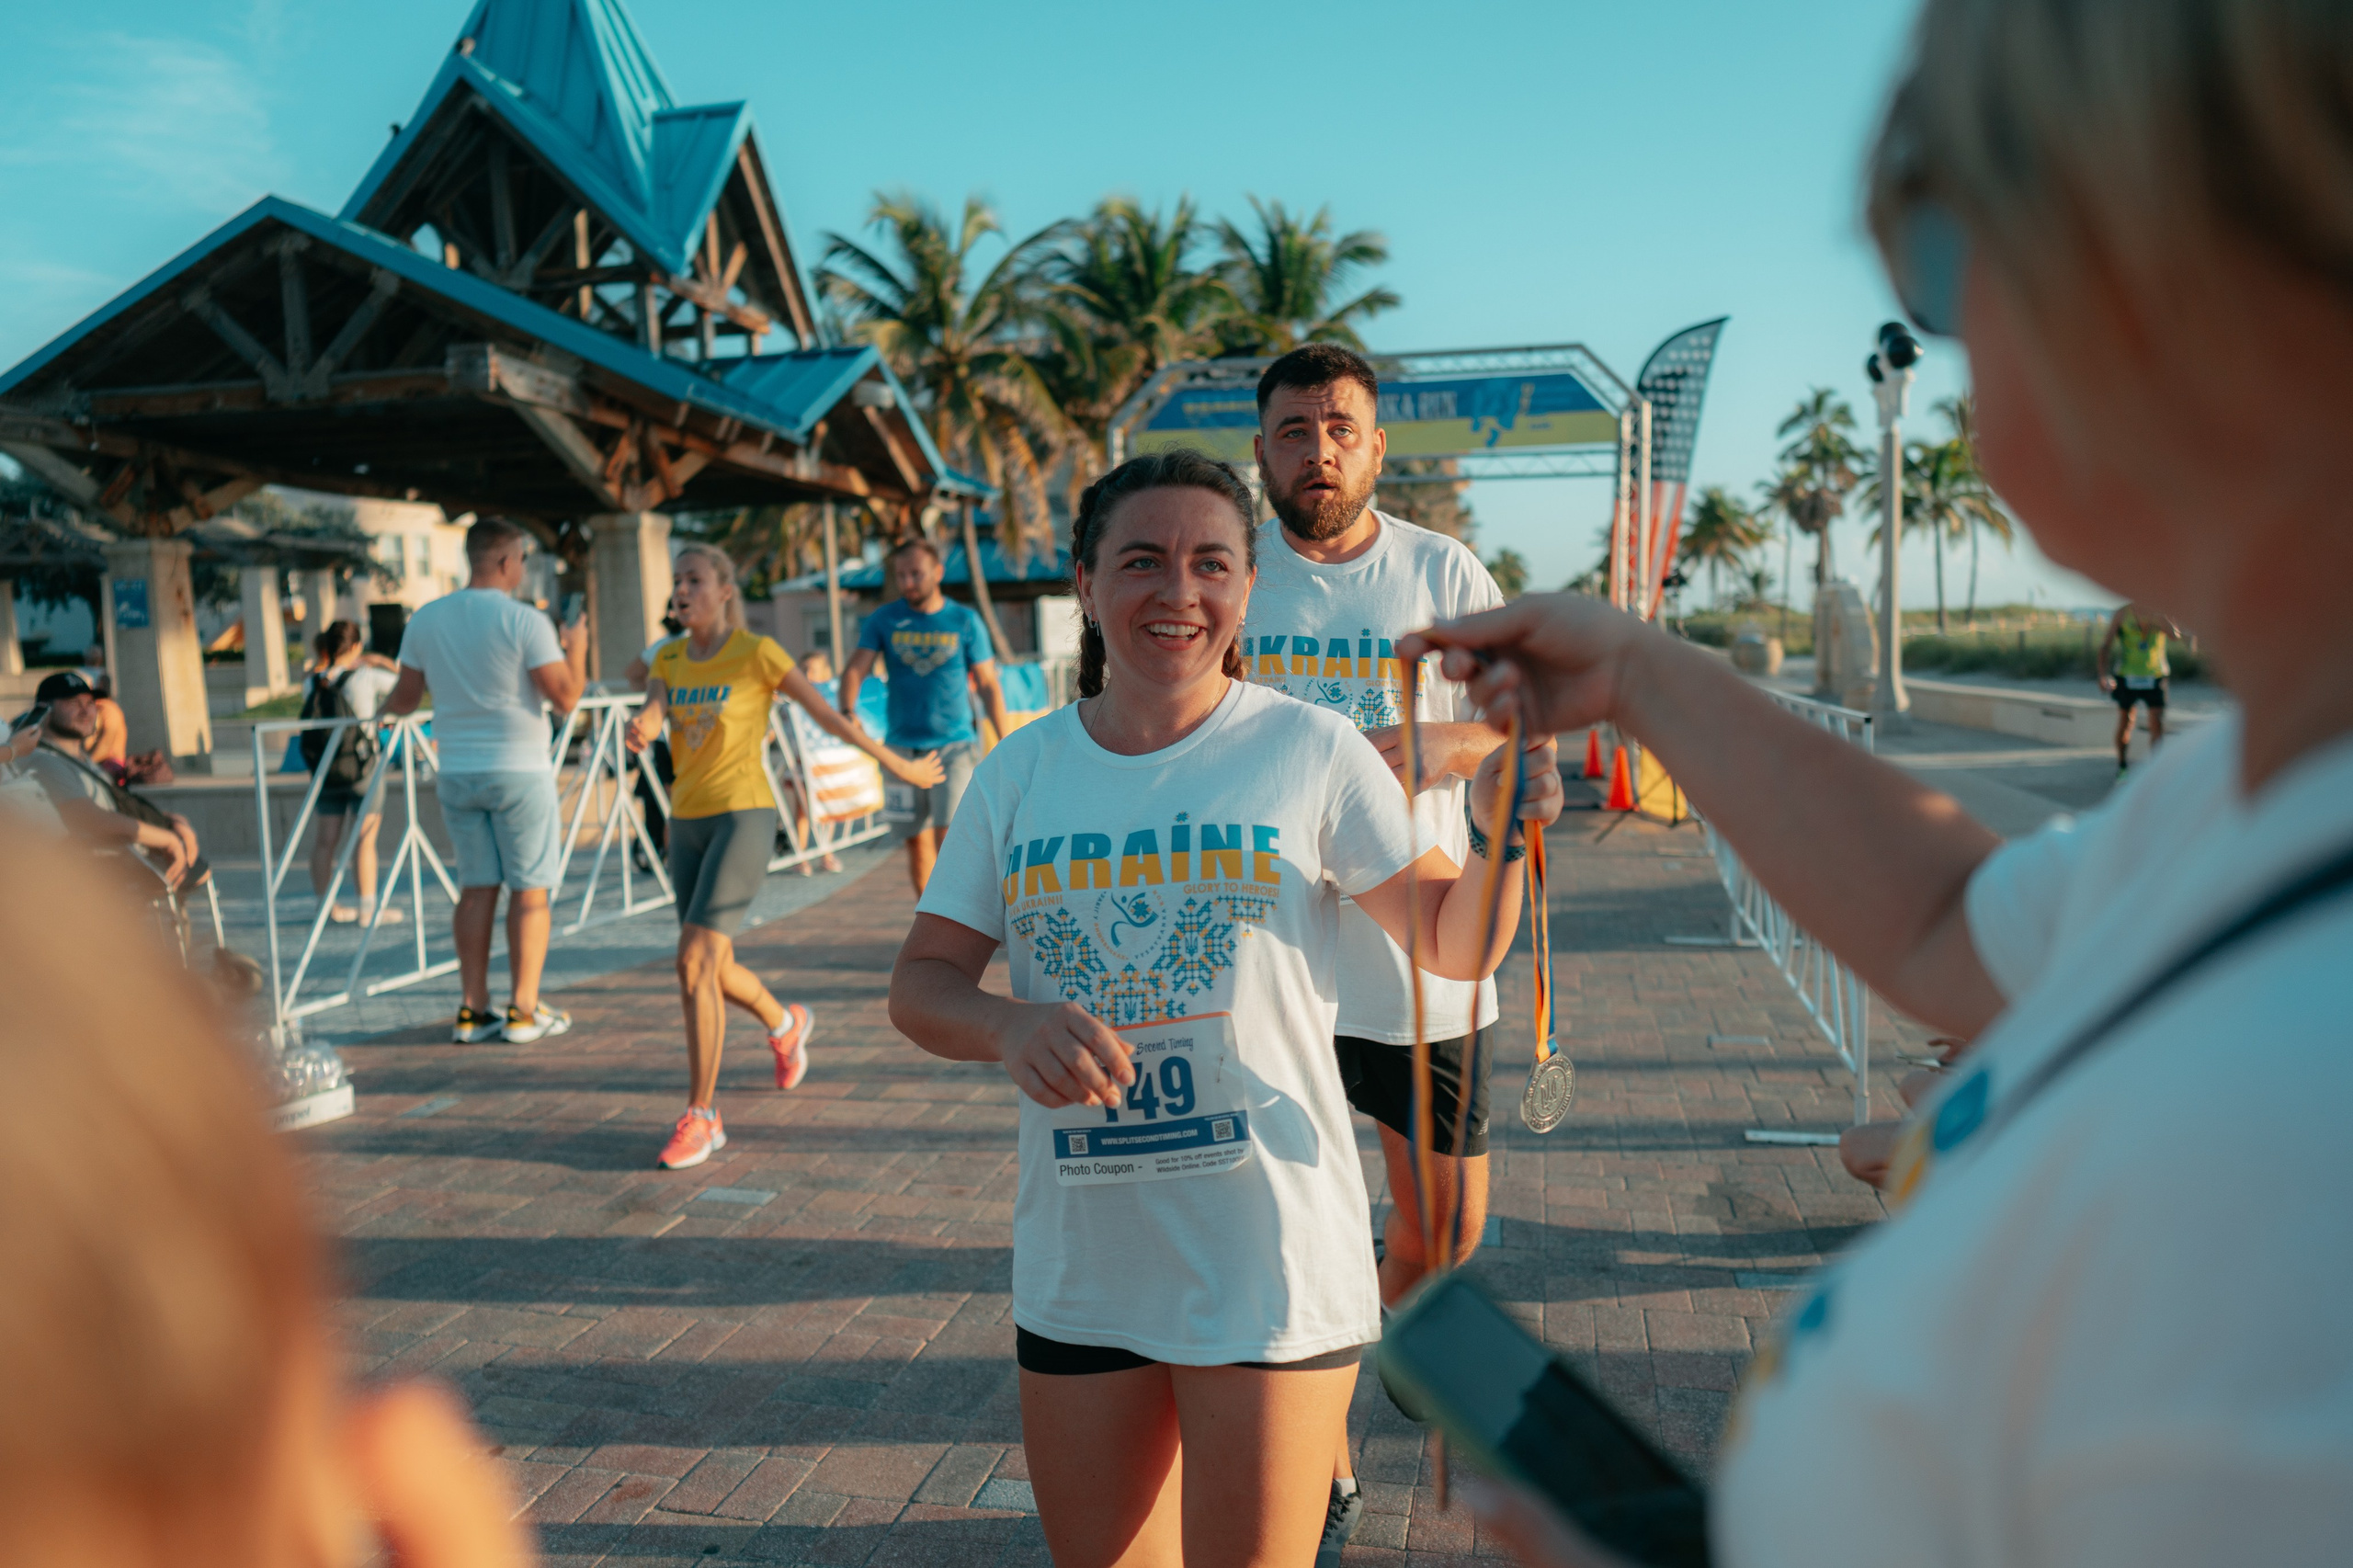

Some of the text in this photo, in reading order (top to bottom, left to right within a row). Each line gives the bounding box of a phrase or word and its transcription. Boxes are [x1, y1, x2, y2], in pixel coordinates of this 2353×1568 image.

[1002, 812, 1281, 906] UKRAINE
[1183, 881, 1279, 898] GLORY TO HEROES!
[1021, 894, 1063, 911] UKRAINI!
[1136, 1037, 1193, 1056] Second Timing
[1100, 1129, 1198, 1146] WWW.SPLITSECONDTIMING.COM
[1223, 1148, 1236, 1156] shot
[1060, 1164, 1091, 1176] Photo
[1094, 1162, 1134, 1176] Coupon
[1155, 1165, 1180, 1173] Wildside
[1181, 1162, 1201, 1170] Online.
